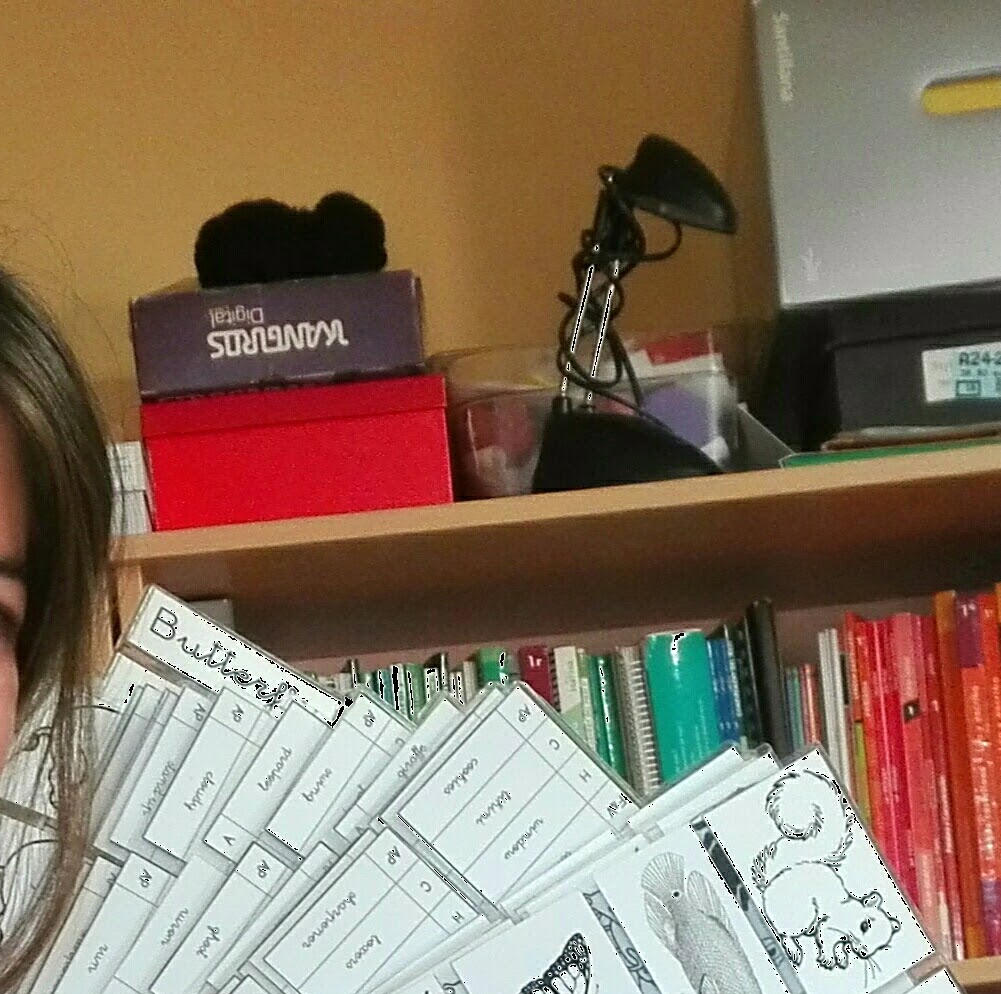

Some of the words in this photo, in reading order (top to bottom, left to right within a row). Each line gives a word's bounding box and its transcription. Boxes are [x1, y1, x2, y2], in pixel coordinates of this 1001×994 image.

[209, 305, 264, 328] Digital
[207, 319, 349, 358] KANGUROS
[232, 706, 245, 724] AP
[362, 709, 377, 729] AP
[517, 703, 532, 723] AP
[548, 738, 561, 752] C
[257, 746, 294, 793] leopard
[443, 757, 479, 796] cookies
[578, 769, 593, 784] H
[184, 770, 216, 811] cloudy
[504, 817, 545, 861] window
[387, 845, 402, 866] AP
[139, 869, 153, 889] AP
[256, 859, 270, 879] AP
[419, 880, 432, 893] C
[302, 891, 357, 949] sharpener
[452, 910, 465, 924] H
[88, 943, 109, 974] run
